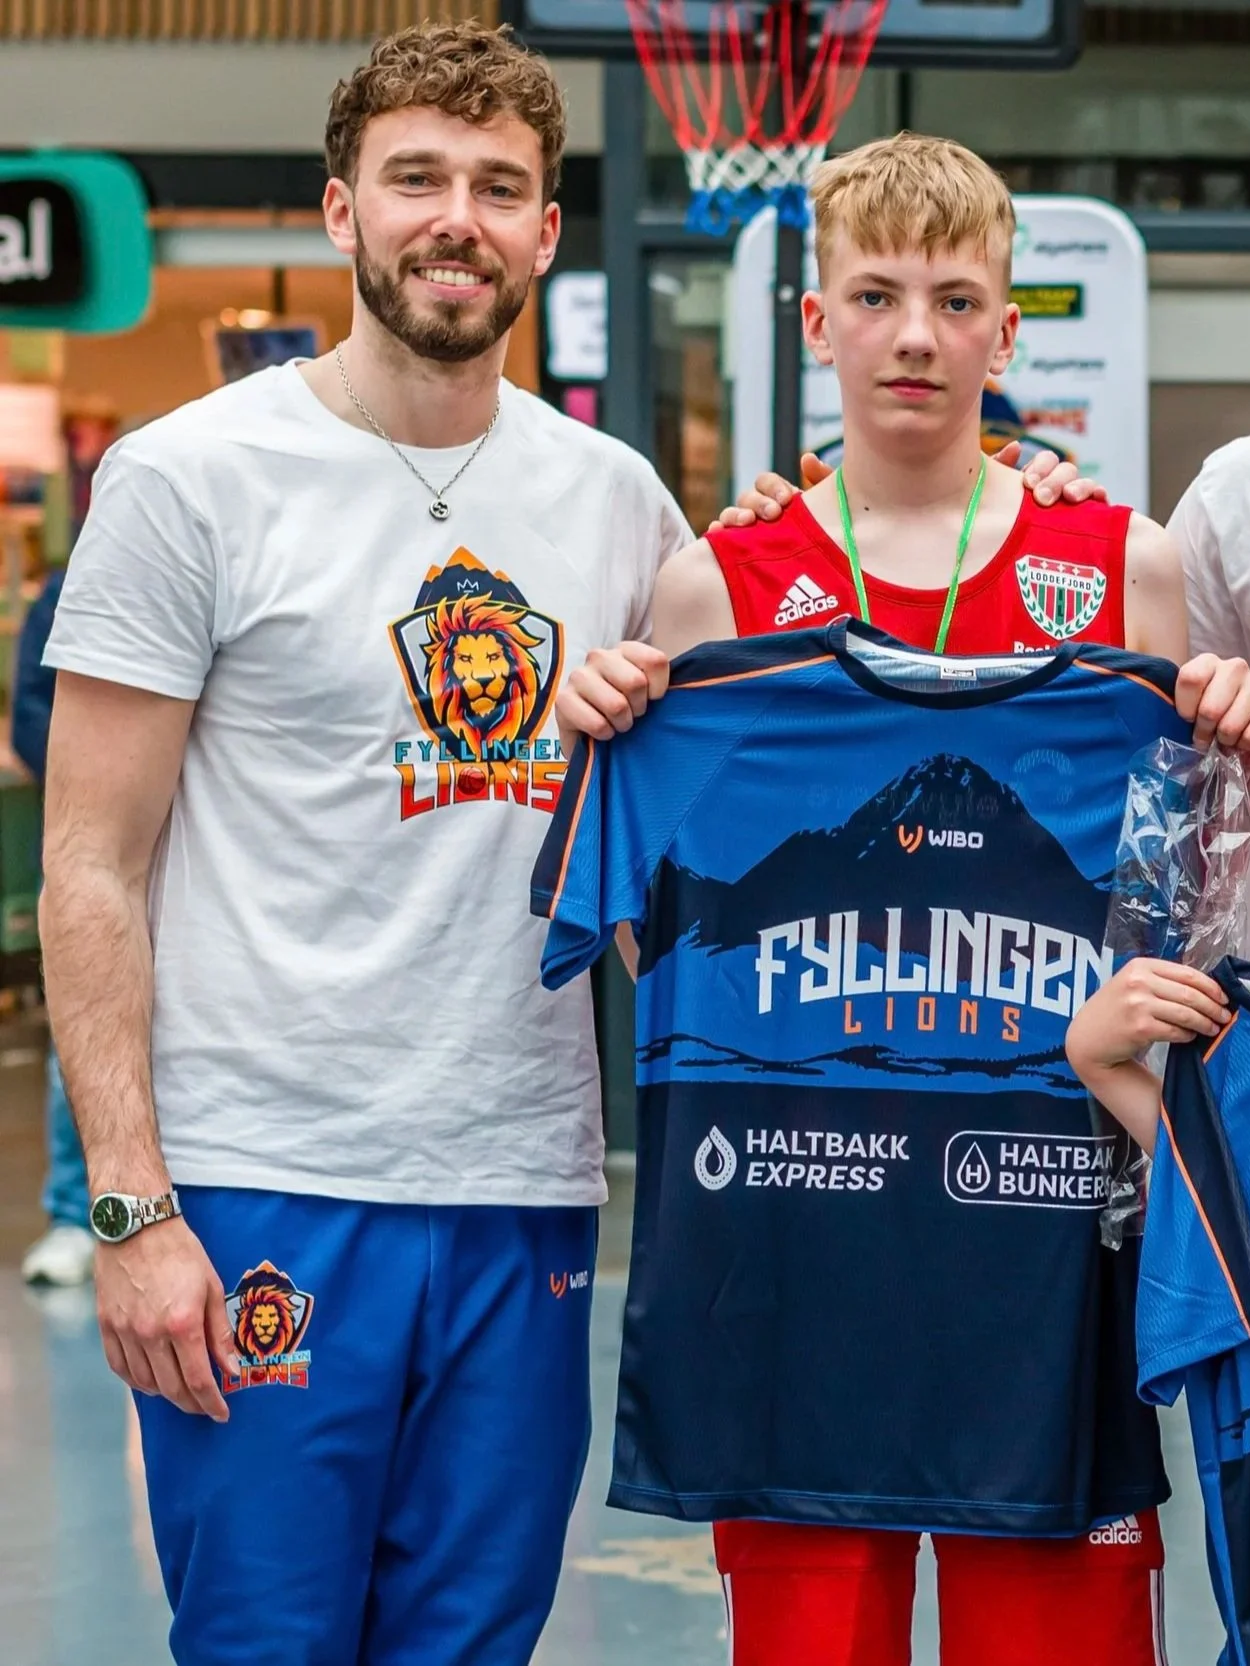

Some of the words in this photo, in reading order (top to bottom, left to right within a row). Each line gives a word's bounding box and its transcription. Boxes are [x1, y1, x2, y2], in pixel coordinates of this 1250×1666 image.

[1030, 571, 1092, 591] LODDEFJORD
[774, 595, 839, 626] adidas
[393, 760, 569, 822] LIONS
[928, 828, 984, 849] WIBO
[844, 997, 1021, 1042] LIONS
[746, 1128, 910, 1161] HALTBAKK
[999, 1142, 1115, 1171] HALTBAK
[746, 1162, 886, 1192] EXPRESS
